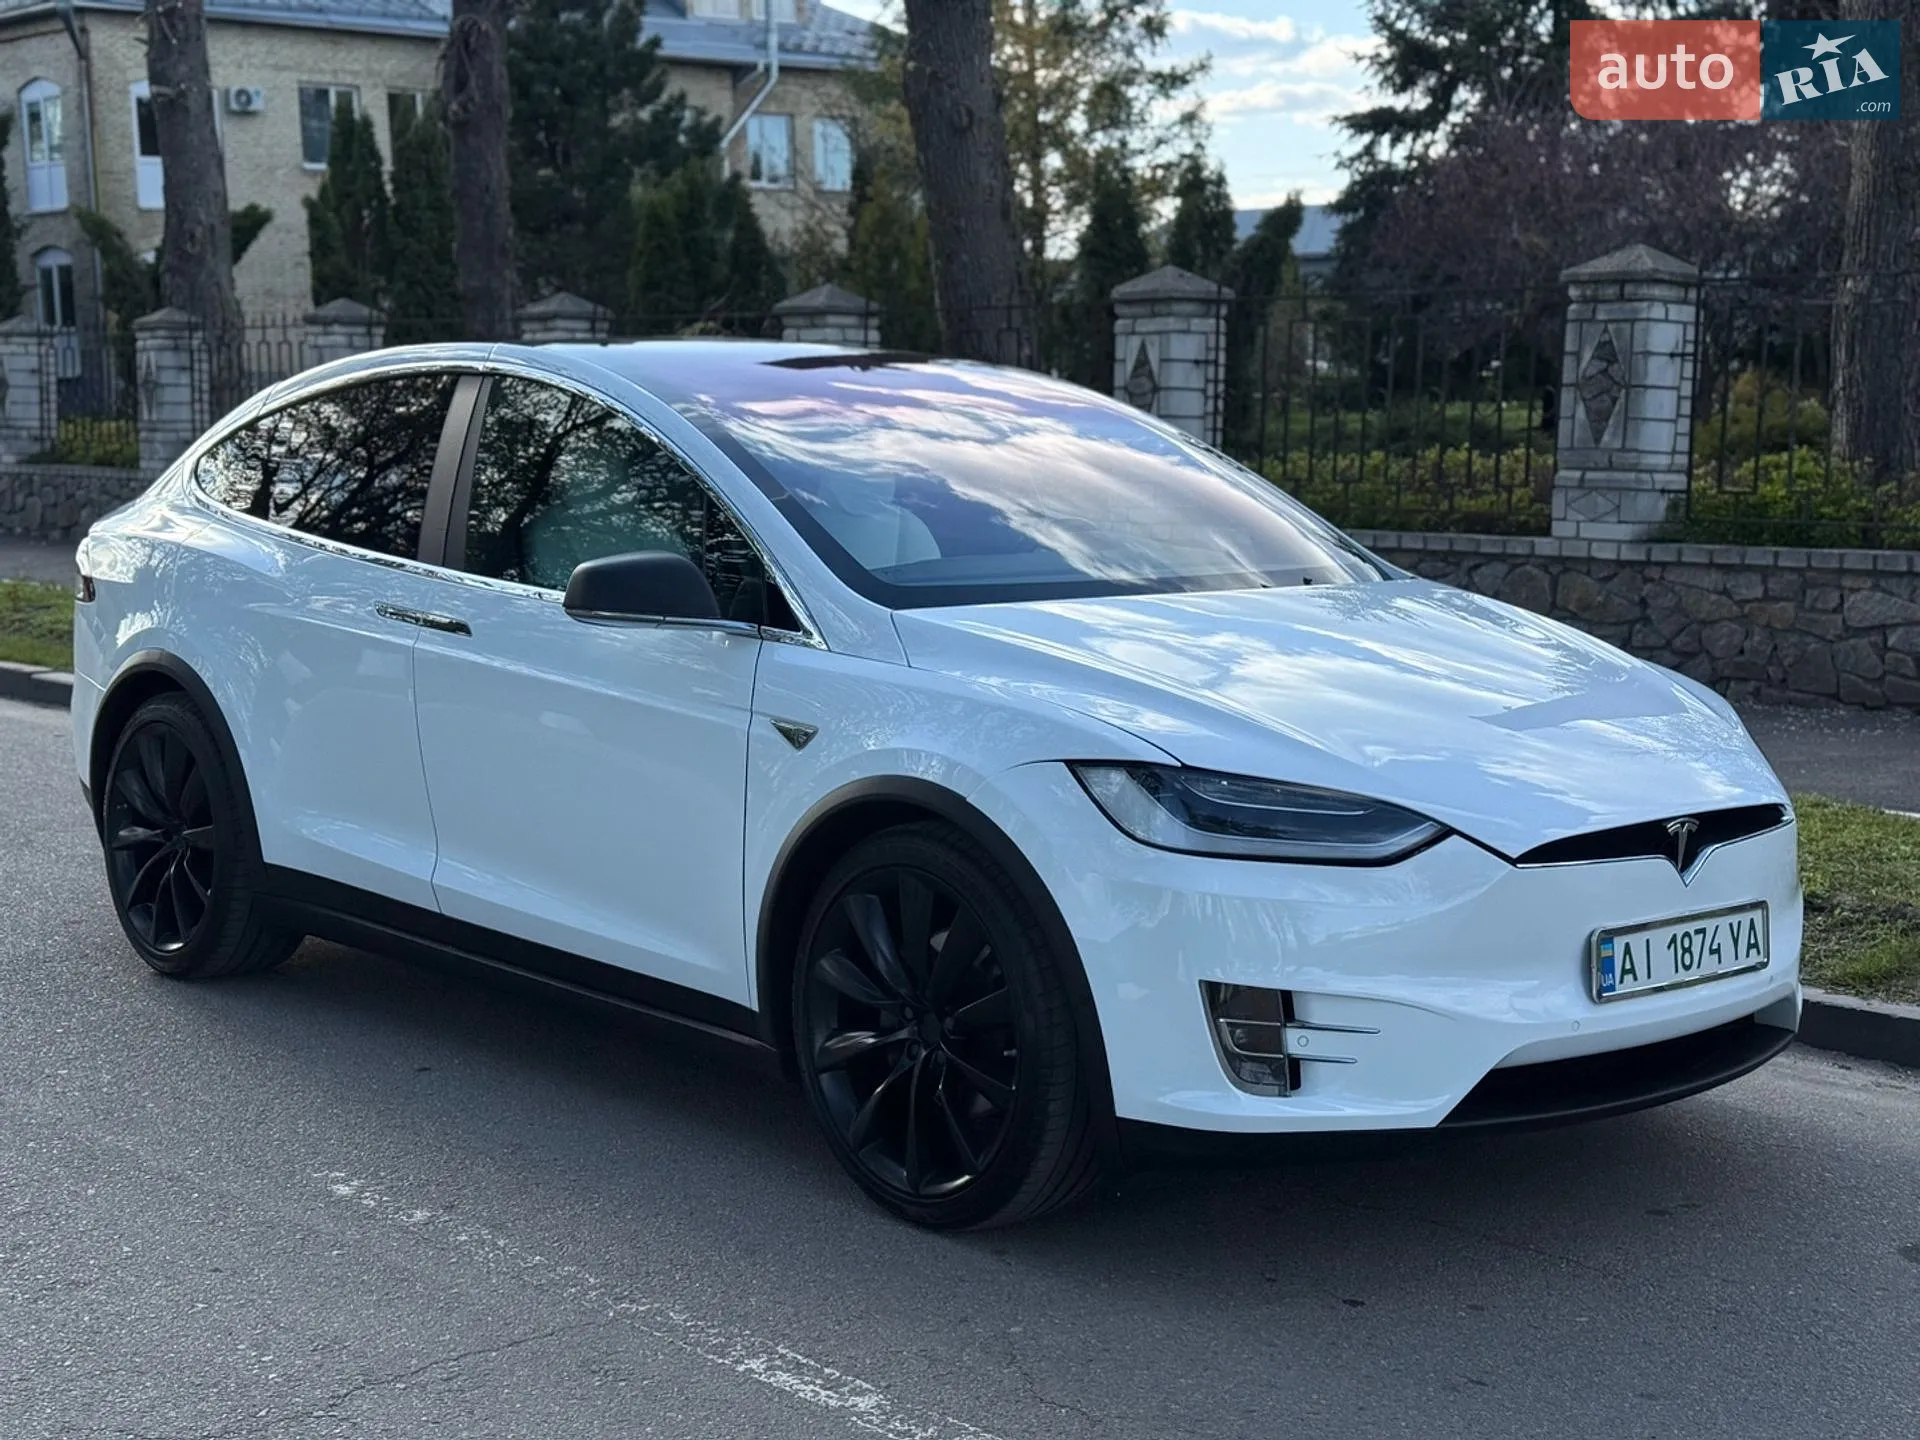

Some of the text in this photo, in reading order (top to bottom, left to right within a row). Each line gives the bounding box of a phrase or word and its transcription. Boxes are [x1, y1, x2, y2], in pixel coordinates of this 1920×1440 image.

[1619, 917, 1761, 985] AI 1874 YA
[1602, 973, 1615, 987] UA
